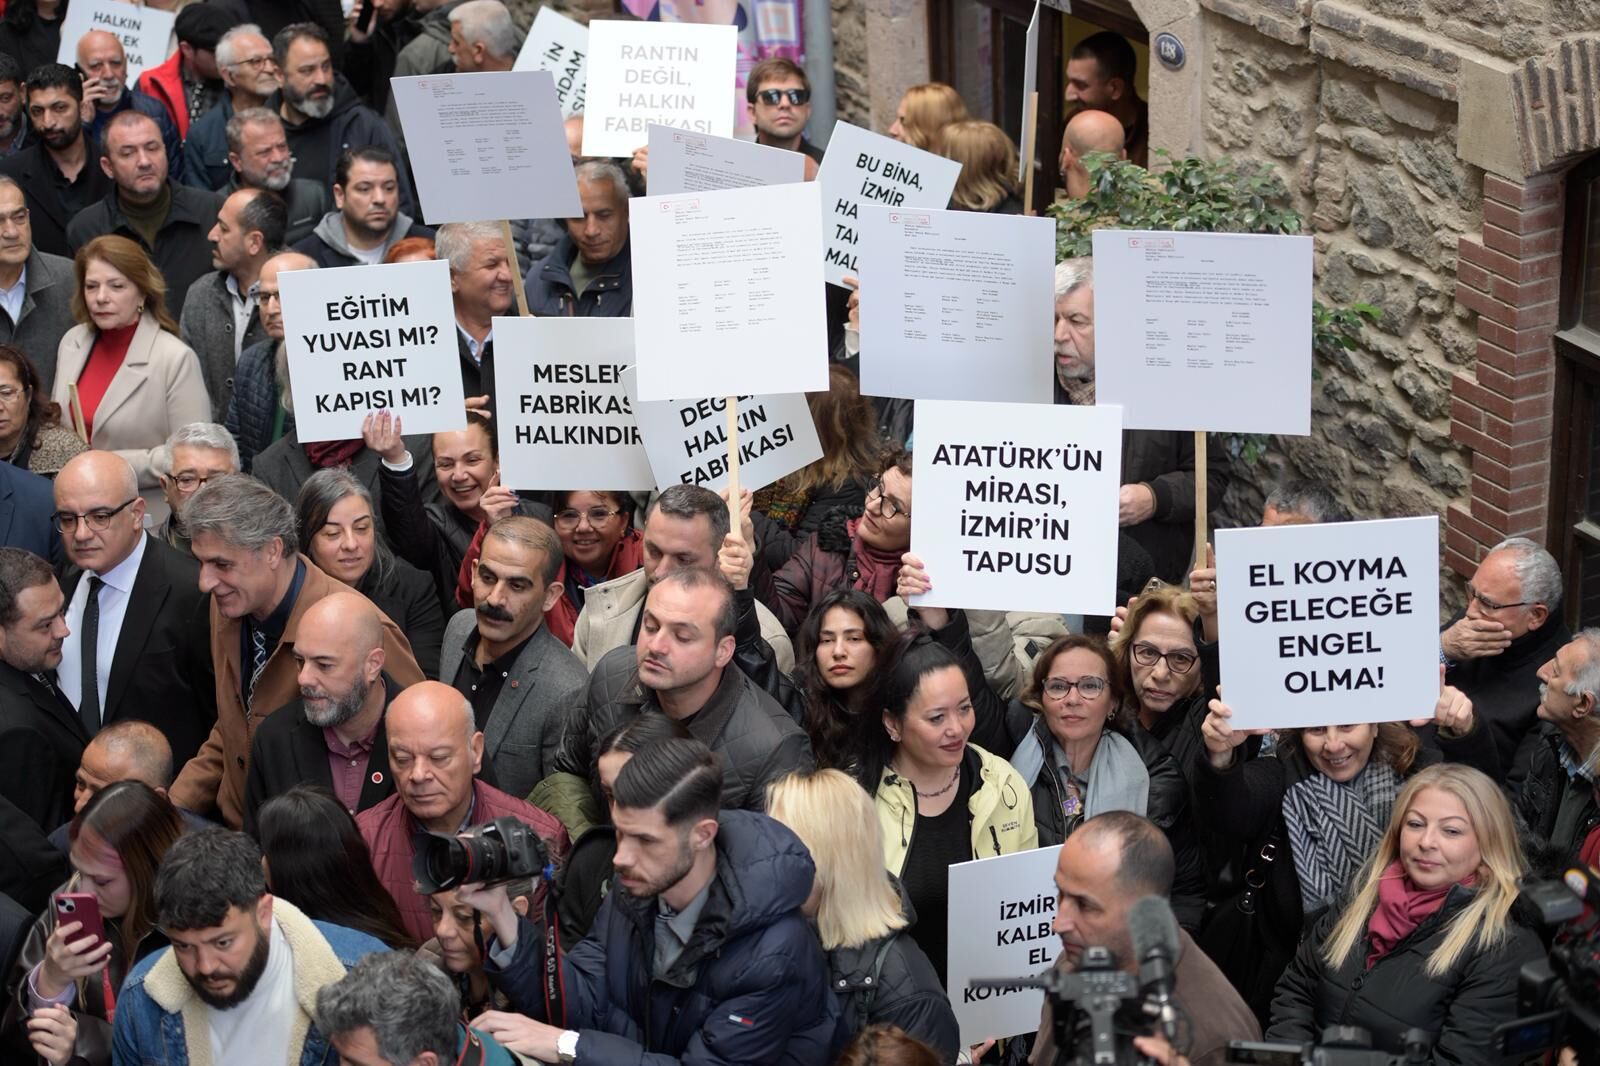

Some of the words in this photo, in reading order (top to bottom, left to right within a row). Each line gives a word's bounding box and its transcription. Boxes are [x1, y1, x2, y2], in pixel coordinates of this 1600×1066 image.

[93, 11, 142, 31] HALKIN
[620, 45, 699, 62] RANTIN
[556, 50, 586, 108] HDAM
[624, 66, 692, 88] DEĞİL,
[618, 93, 696, 111] HALKIN
[855, 152, 881, 173] BU
[882, 161, 924, 192] BİNA,
[860, 177, 905, 207] İZMİR
[835, 198, 858, 220] HA
[836, 224, 859, 246] TA
[825, 247, 858, 273] MAL
[326, 293, 410, 321] EĞİTİM
[302, 329, 391, 354] YUVASI
[398, 325, 439, 347] MI?
[342, 358, 407, 381] RANT
[533, 364, 629, 384] MESLEK
[315, 389, 394, 413] KAPISI
[401, 386, 441, 408] MI?
[520, 389, 633, 415] FABRİKAS
[515, 425, 643, 445] HALKINDIR
[931, 440, 1102, 472] ATATÜRK’ÜN
[965, 475, 1067, 510] MİRASI,
[960, 509, 1069, 541] İZMİR’İN
[962, 550, 1072, 577] TAPUSU
[1249, 564, 1285, 587] EL
[1294, 556, 1408, 585] KOYMA
[1244, 587, 1413, 624] GELECEĞE
[1278, 631, 1382, 658] ENGEL
[1284, 666, 1384, 694] OLMA!
[1000, 893, 1056, 921] İZMİR
[1029, 947, 1052, 965] EL
